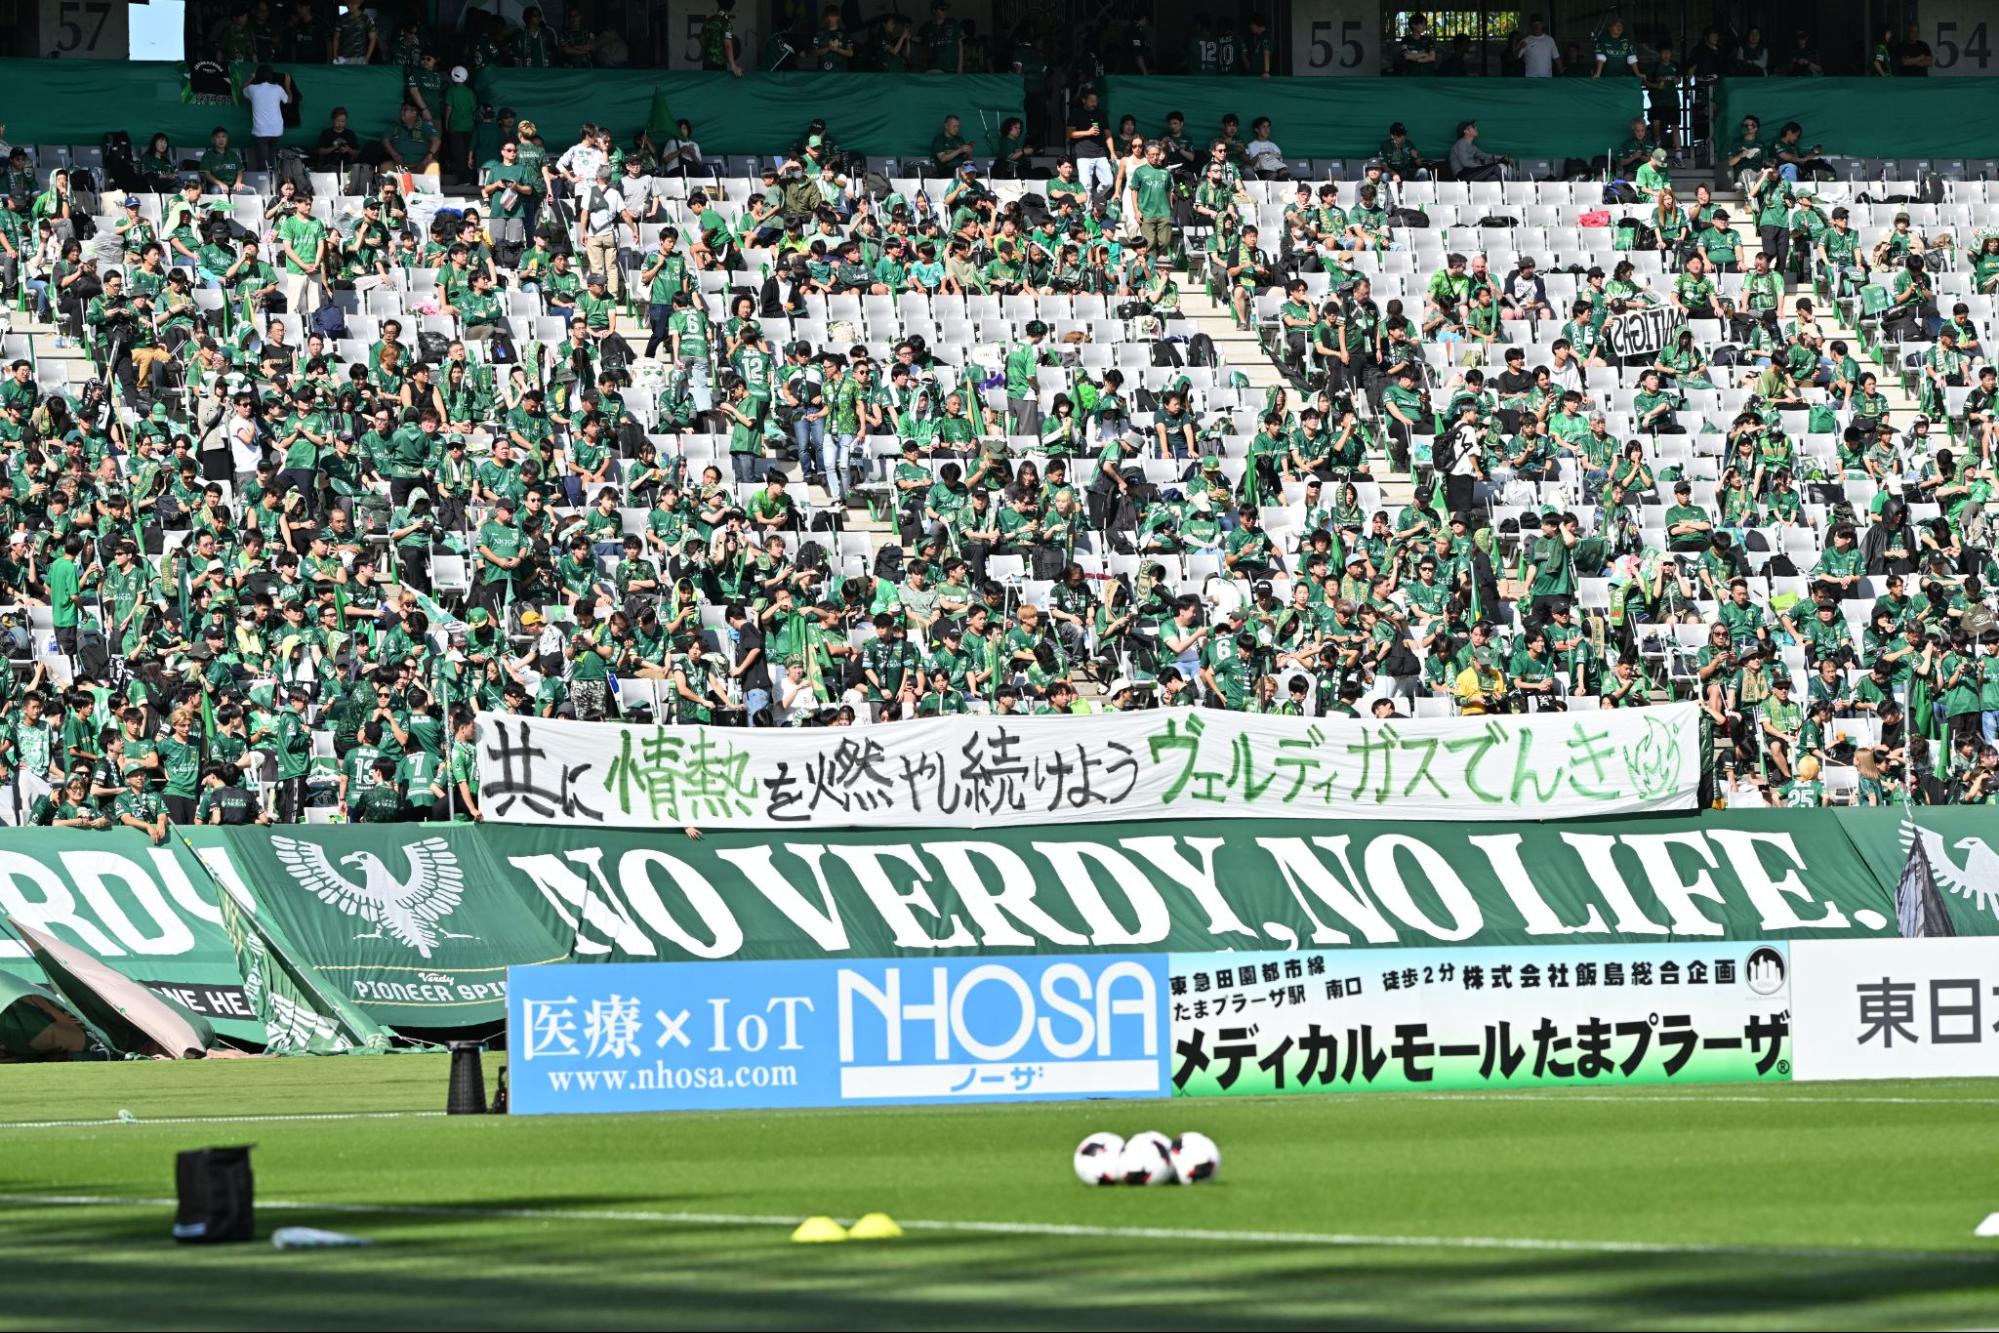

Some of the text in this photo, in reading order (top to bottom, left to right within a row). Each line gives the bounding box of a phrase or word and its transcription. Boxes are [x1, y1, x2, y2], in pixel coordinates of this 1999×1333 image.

[57, 2, 112, 52] 57
[1308, 20, 1365, 68] 55
[1934, 21, 1992, 69] 54
[686, 314, 700, 335] 6
[741, 357, 763, 381] 12
[1216, 639, 1231, 660] 6
[408, 753, 425, 778] 7
[1787, 785, 1815, 808] 25
[0, 847, 256, 957] RDY
[508, 829, 1888, 959] NO VERDY, NO LIFE.
[418, 972, 455, 986] Verdy
[1168, 955, 1326, 996] 東急田園都市線
[1462, 958, 1737, 990] 株式会社飯島総合企画
[150, 986, 207, 1012] NE
[353, 980, 455, 1002] PIONEER
[1174, 962, 1456, 1021] たまプラーザ駅 南口 徒歩2分
[837, 961, 1159, 1063] NHOSA
[1172, 1009, 1791, 1091] メディカルモールたまプラーザ
[546, 1064, 798, 1093] www.nhosa.com
[949, 1066, 1045, 1092] ノーザ
